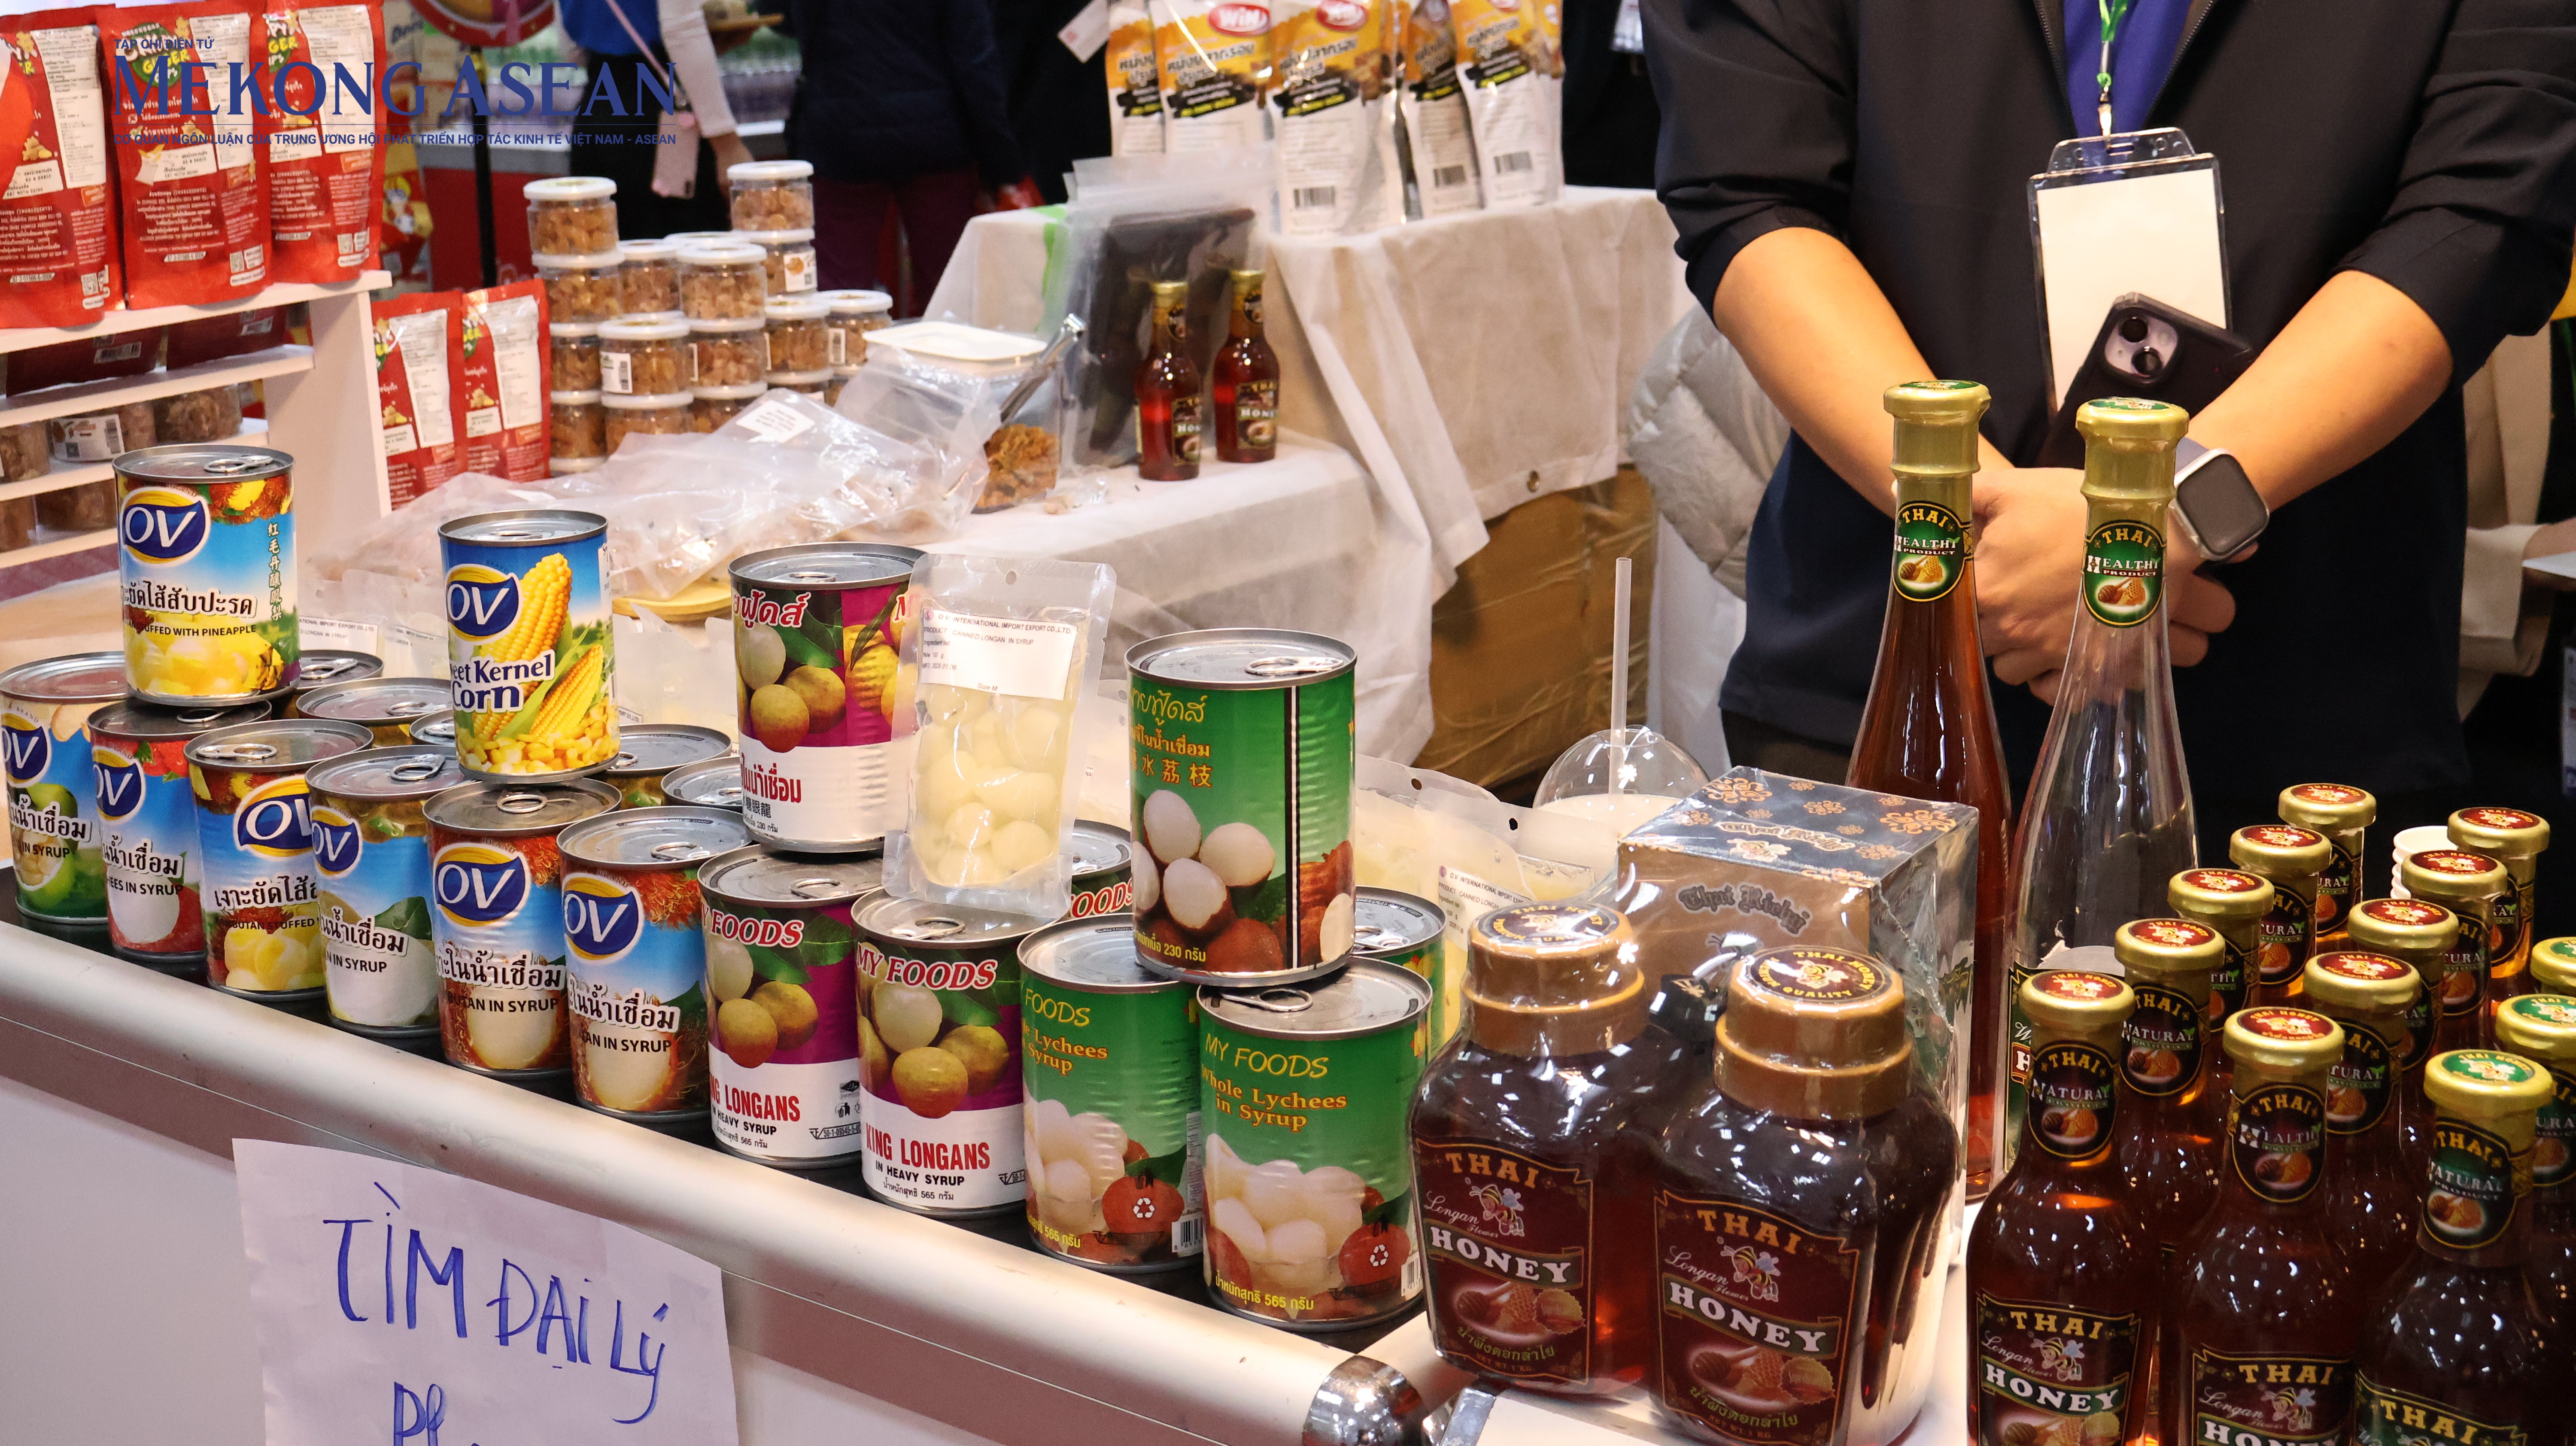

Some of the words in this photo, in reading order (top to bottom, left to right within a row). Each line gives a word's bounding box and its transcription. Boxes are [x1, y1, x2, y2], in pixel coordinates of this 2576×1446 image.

[125, 507, 197, 547] OV
[1902, 508, 1950, 528] THAI
[1894, 534, 1956, 552] HEALTHY
[1902, 547, 1956, 556] PRODUCT
[2102, 528, 2154, 549] THAI
[2087, 555, 2159, 574] HEALTHY
[2103, 569, 2157, 577] PRODUCT
[448, 583, 510, 626] OV
[173, 627, 199, 636] WITH
[202, 624, 256, 636] PINEAPPLE
[953, 617, 1000, 629] INTERNATIONAL
[952, 630, 980, 640] CANNED
[981, 635, 1005, 643] LONGAN
[475, 653, 553, 684] Kernel
[452, 680, 520, 709] Corn
[16, 706, 39, 723] BRAND
[741, 752, 802, 804] ในน้ำเชื่อม
[757, 821, 766, 830] 230
[21, 841, 30, 854] IN
[33, 844, 71, 859] SYRUP
[311, 823, 352, 862] OV
[482, 837, 515, 854] BRAND
[125, 881, 137, 893] IN
[140, 883, 184, 896] SYRUP
[438, 864, 515, 909] OV
[598, 872, 629, 888] BRAND
[1460, 876, 1497, 895] INTERNATIONAL
[1497, 890, 1513, 901] IMPORT
[1459, 891, 1480, 903] CANNED
[564, 893, 628, 943] OV
[712, 909, 803, 946] FOODS
[333, 954, 343, 967] IN
[345, 958, 387, 973] SYRUP
[1163, 943, 1182, 959] 230
[1185, 947, 1206, 962] กรัม
[857, 944, 885, 977] MY
[887, 959, 997, 990] FOODS
[1793, 951, 1845, 962] THAI
[1848, 960, 1876, 990] HONEY
[1783, 986, 1853, 998] QUALITY
[2135, 993, 2182, 1016] THAI
[489, 1000, 504, 1012] IN
[508, 998, 558, 1013] SYRUP
[1025, 988, 1091, 1027] FOODS
[604, 1036, 617, 1050] IN
[621, 1039, 671, 1053] SYRUP
[1034, 1027, 1109, 1060] Lychees
[2121, 1020, 2195, 1043] NATURAL
[1028, 1042, 1073, 1076] Syrup
[1205, 1033, 1229, 1061] MY
[1234, 1048, 1329, 1078] FOODS
[2048, 1051, 2101, 1073] THAI
[725, 1084, 801, 1122] LONGANS
[1251, 1087, 1348, 1110] Lychees
[2031, 1078, 2110, 1102] NATURAL
[1216, 1093, 1233, 1115] in
[1239, 1103, 1308, 1133] Syrup
[2259, 1093, 2313, 1115] THAI
[717, 1109, 739, 1128] HEAVY
[743, 1121, 777, 1136] SYRUP
[741, 1137, 752, 1146] 565
[754, 1139, 768, 1149] กรัม
[866, 1122, 893, 1161] KING
[901, 1137, 990, 1170] LONGANS
[2435, 1130, 2494, 1162] THAI
[875, 1160, 883, 1173] IN
[887, 1164, 920, 1183] HEAVY
[925, 1174, 965, 1187] SYRUP
[1446, 1152, 1539, 1189] THAI
[921, 1190, 936, 1199] 565
[938, 1190, 954, 1201] กรัม
[1423, 1191, 1479, 1225] Longan
[1044, 1226, 1059, 1242] 565
[1061, 1233, 1081, 1249] กรัม
[1696, 1209, 1802, 1255] THAI
[322, 1181, 468, 1339] TÌM
[1430, 1226, 1571, 1283] HONEY
[1664, 1245, 1729, 1285] Longan
[1264, 1293, 1287, 1308] 565
[1290, 1294, 1315, 1312] กรัม
[1669, 1281, 1827, 1352] HONEY
[2010, 1311, 2103, 1340] THAI
[1981, 1330, 2034, 1366] Longan
[2238, 1364, 2334, 1385] THAI
[1985, 1363, 2119, 1413] HONEY
[2198, 1386, 2265, 1420] Longan
[2379, 1398, 2478, 1446] THAI
